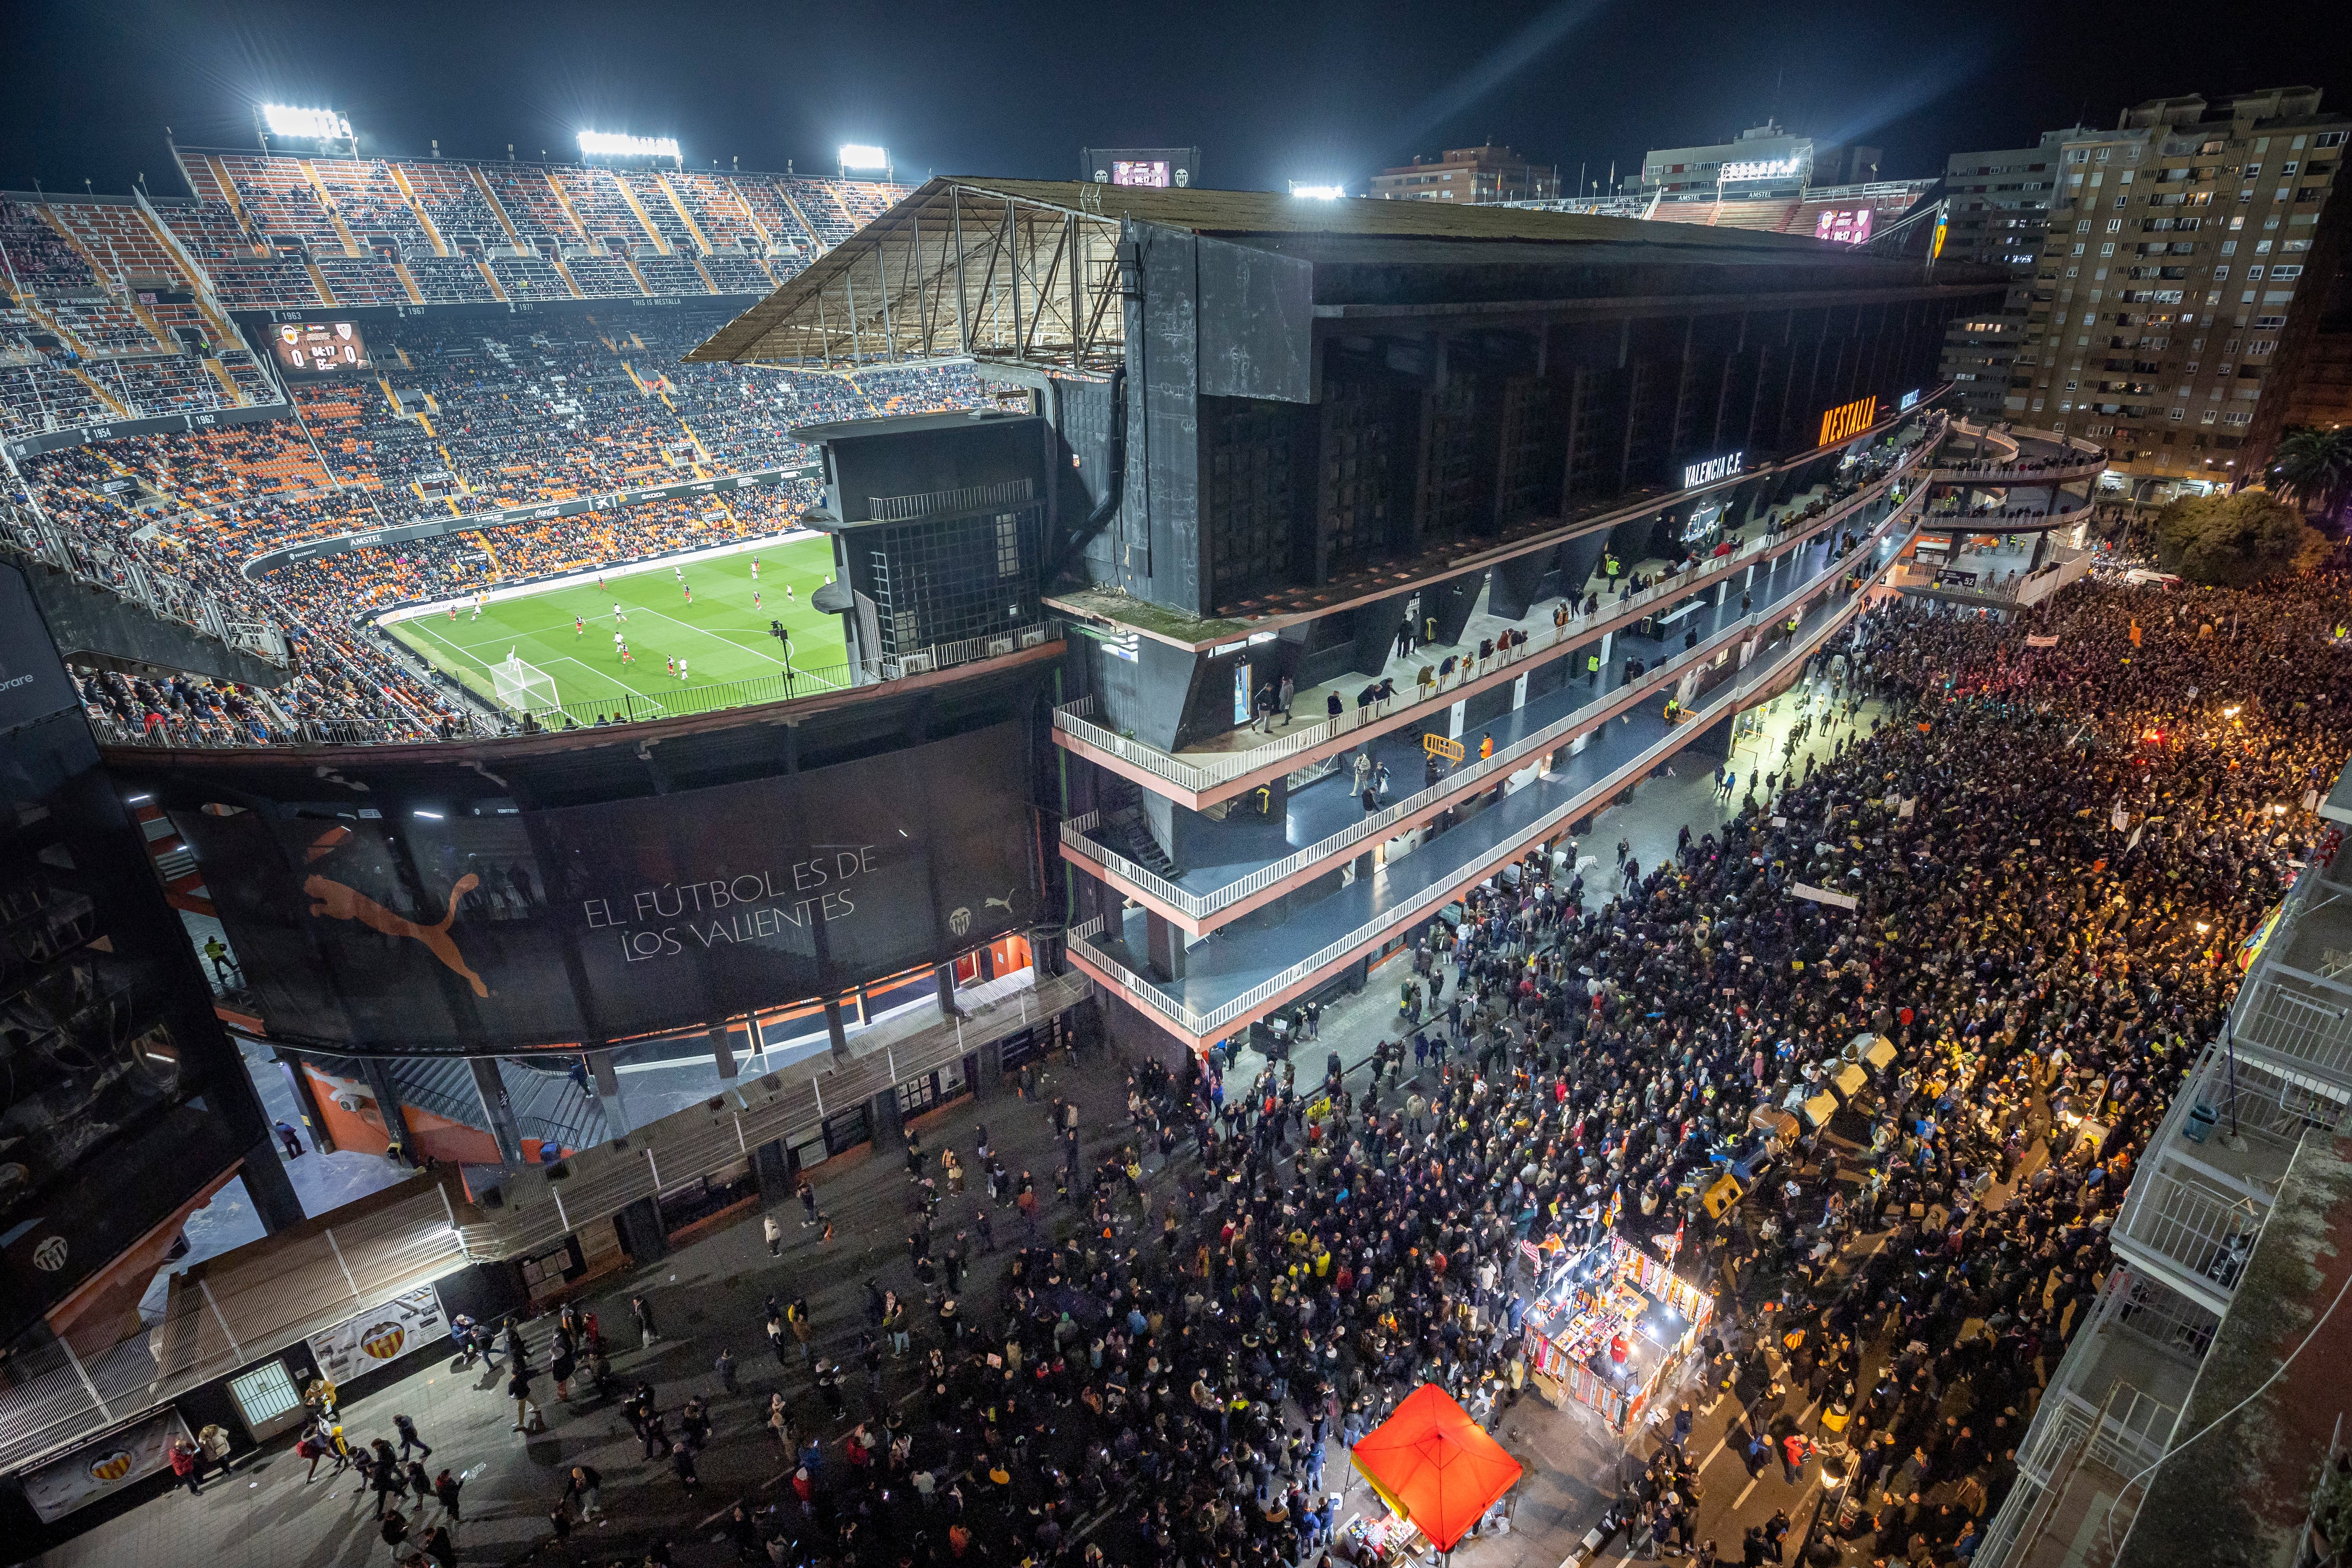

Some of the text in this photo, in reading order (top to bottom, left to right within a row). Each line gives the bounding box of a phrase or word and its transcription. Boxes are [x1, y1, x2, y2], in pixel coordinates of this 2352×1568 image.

[282, 311, 302, 320] 1963
[408, 307, 425, 315] 1967
[311, 345, 335, 357] 04:17
[344, 345, 356, 363] 0
[291, 348, 304, 367] 0
[195, 414, 215, 425] 1962
[1819, 396, 1876, 447] MESTALLA
[93, 428, 111, 439] 1954
[15, 444, 26, 456] 1949
[1685, 451, 1742, 489] VALENCIA C.F.
[641, 491, 667, 500] ŠKODA
[350, 534, 382, 546] AMSTEL
[0, 674, 34, 691] orare
[583, 846, 878, 928] EL FÚTBOL ES DE
[621, 888, 855, 961] LOS VALIENTES
